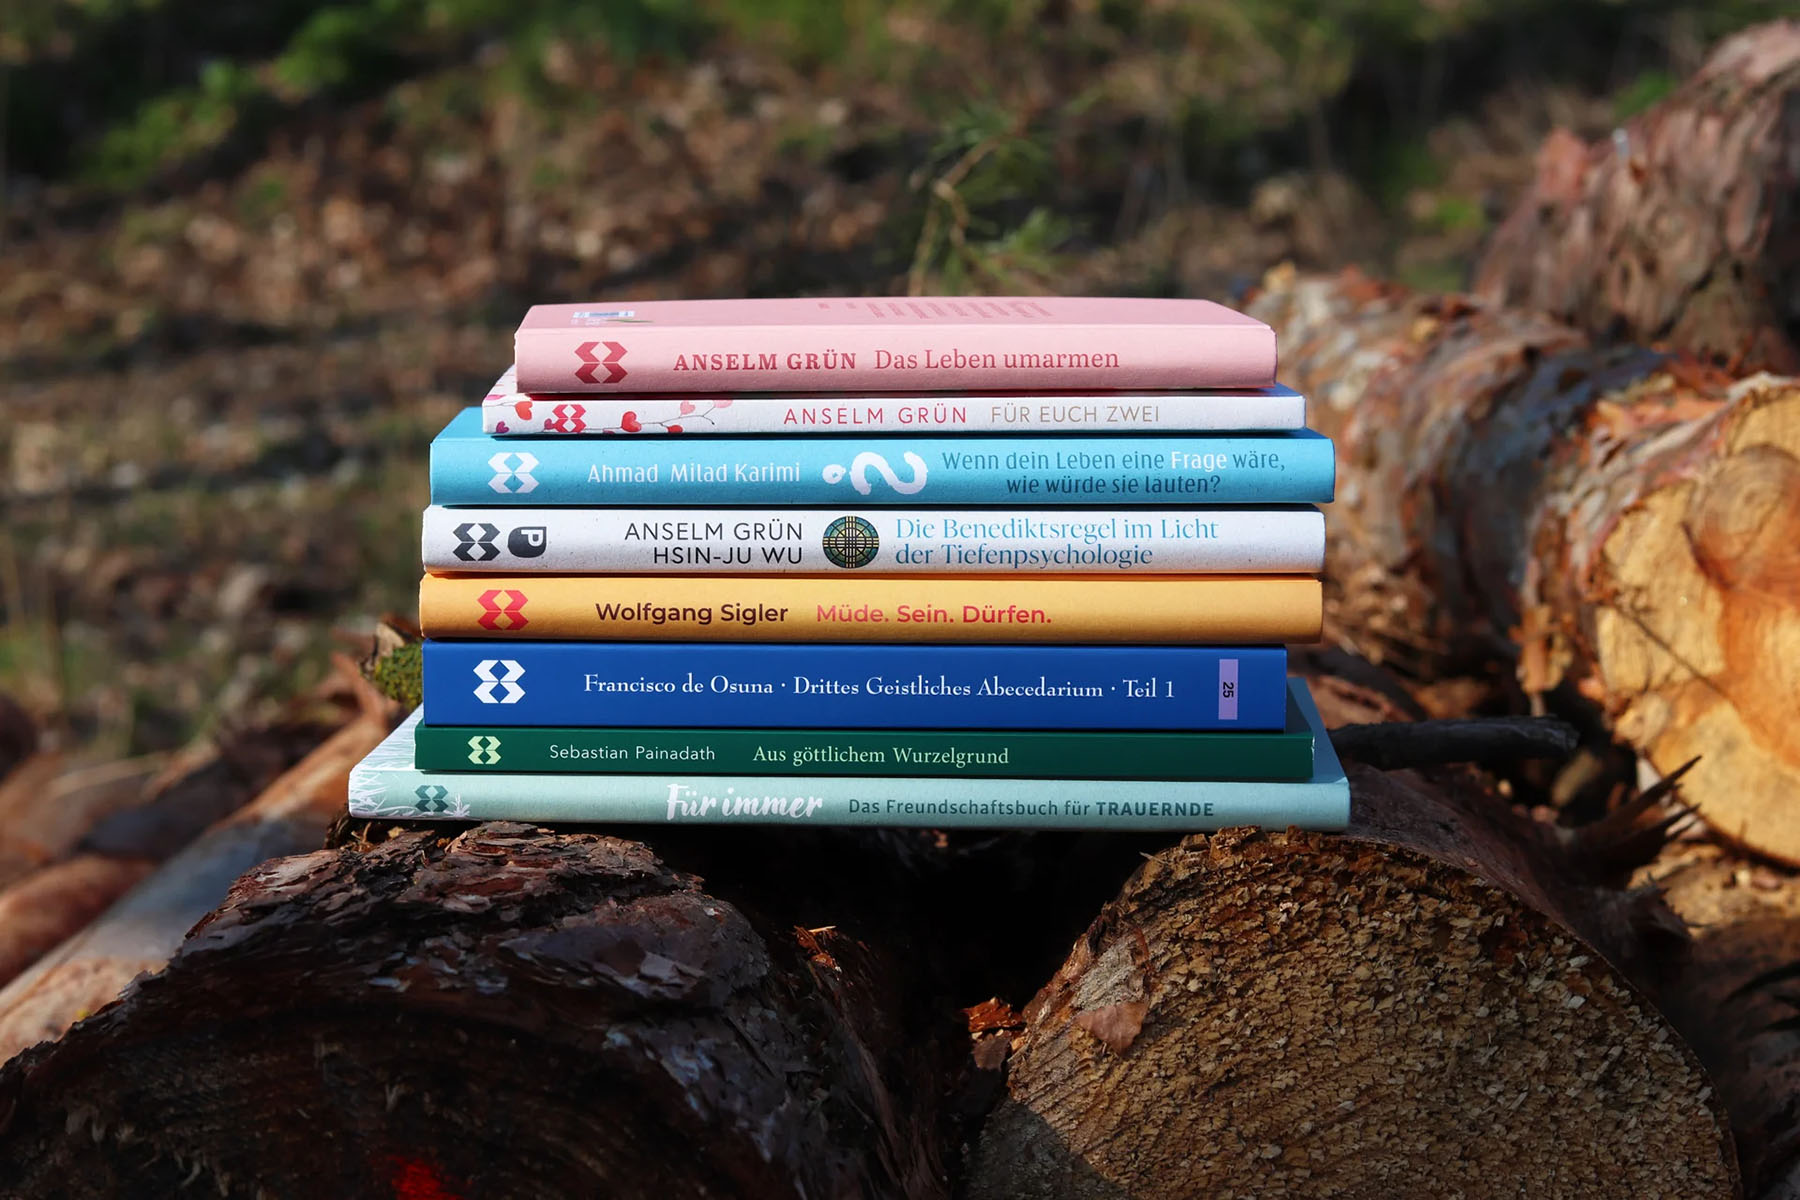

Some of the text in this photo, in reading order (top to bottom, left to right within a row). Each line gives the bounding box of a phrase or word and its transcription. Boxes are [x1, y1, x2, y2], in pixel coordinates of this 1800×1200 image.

[672, 348, 857, 371] ANSELM GRÜN
[874, 348, 1120, 370] Das Leben umarmen
[783, 402, 966, 425] ANSELM GRÜN
[991, 402, 1159, 424] FÜR EUCH ZWEI
[587, 462, 800, 484] Ahmad Milad Karimi
[941, 450, 1285, 473] Wenn dein Leben eine Frage wäre,
[1006, 474, 1221, 494] wie würde sie lauten?
[624, 518, 802, 541] ANSELM GRÜN
[896, 517, 1218, 545] Die Benediktsregel im Licht
[653, 546, 802, 565] HSIN-JU WU
[895, 542, 1153, 571] der Tiefenpsychologie
[595, 602, 789, 626] Wolfgang Sigler
[816, 603, 1052, 624] Müde. Sein. Dürfen.
[584, 673, 676, 693] Francisco
[681, 672, 704, 693] de
[710, 675, 773, 694] Osuna
[793, 676, 859, 695] Drittes
[865, 674, 971, 696] Geistliches
[976, 675, 1103, 697] Abecedarium
[1122, 677, 1156, 698] Teil
[1222, 681, 1235, 698] 25
[549, 744, 715, 761] Sebastian Painadath
[752, 745, 1009, 769] Aus göttlichem Wurzelgrund
[666, 783, 823, 821] Für immer
[849, 798, 1214, 817] Das Freundschaftsbuch für TRAUERNDE
